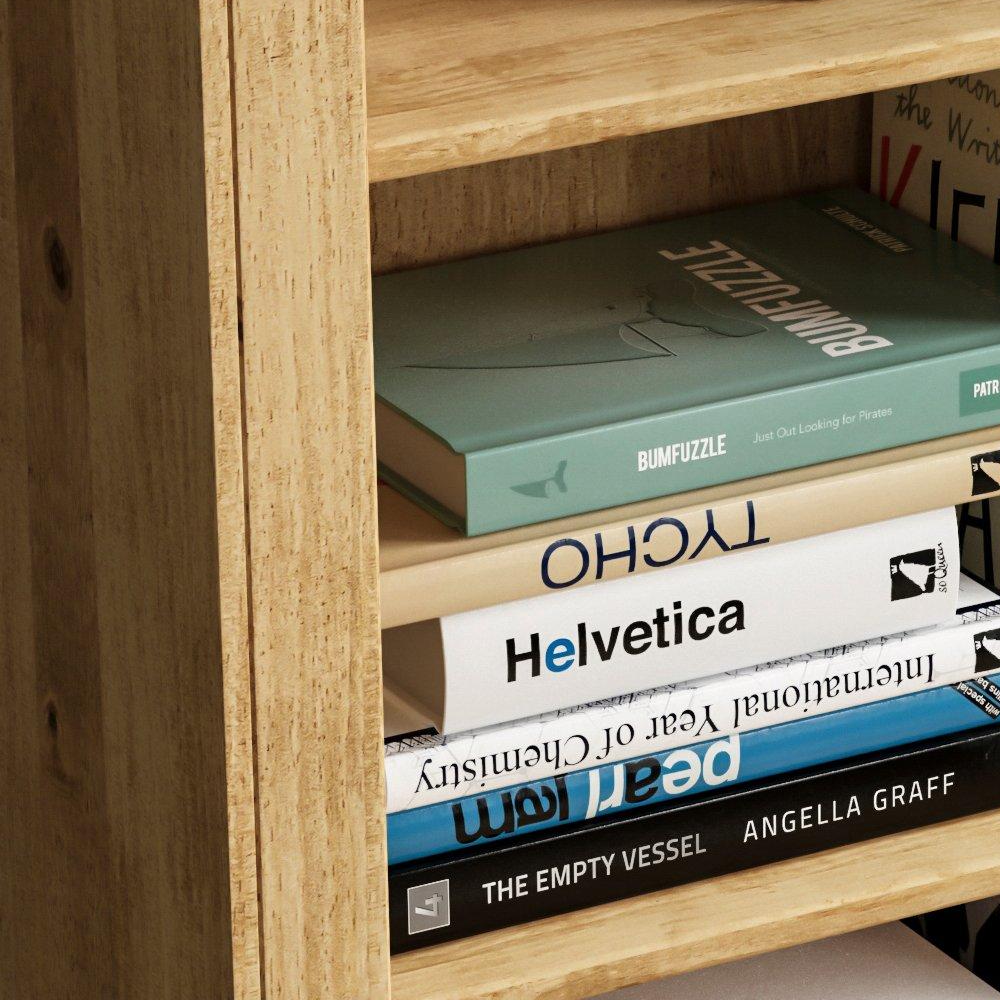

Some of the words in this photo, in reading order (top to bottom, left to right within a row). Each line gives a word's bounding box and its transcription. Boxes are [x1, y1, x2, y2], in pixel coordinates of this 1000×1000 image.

[894, 84, 933, 130] the
[657, 240, 895, 358] BUMFUZZLE
[636, 433, 727, 473] BUMFUZZLE
[753, 431, 774, 444] Just
[776, 425, 796, 440] Out
[799, 416, 841, 434] Looking
[842, 413, 856, 427] for
[858, 407, 893, 422] Pirates
[540, 500, 770, 589] TYCHO
[934, 542, 949, 579] Queen
[938, 581, 947, 593] so
[506, 599, 745, 683] Helvetica
[733, 653, 936, 729] International
[985, 701, 1000, 717] with
[596, 723, 635, 760] of
[645, 705, 721, 742] Year
[414, 734, 590, 794] Chemistry
[482, 873, 529, 905] THE
[536, 854, 615, 893] EMPTY
[622, 833, 707, 871] VESSEL
[743, 801, 861, 843] ANGELLA
[873, 772, 956, 811] GRAFF
